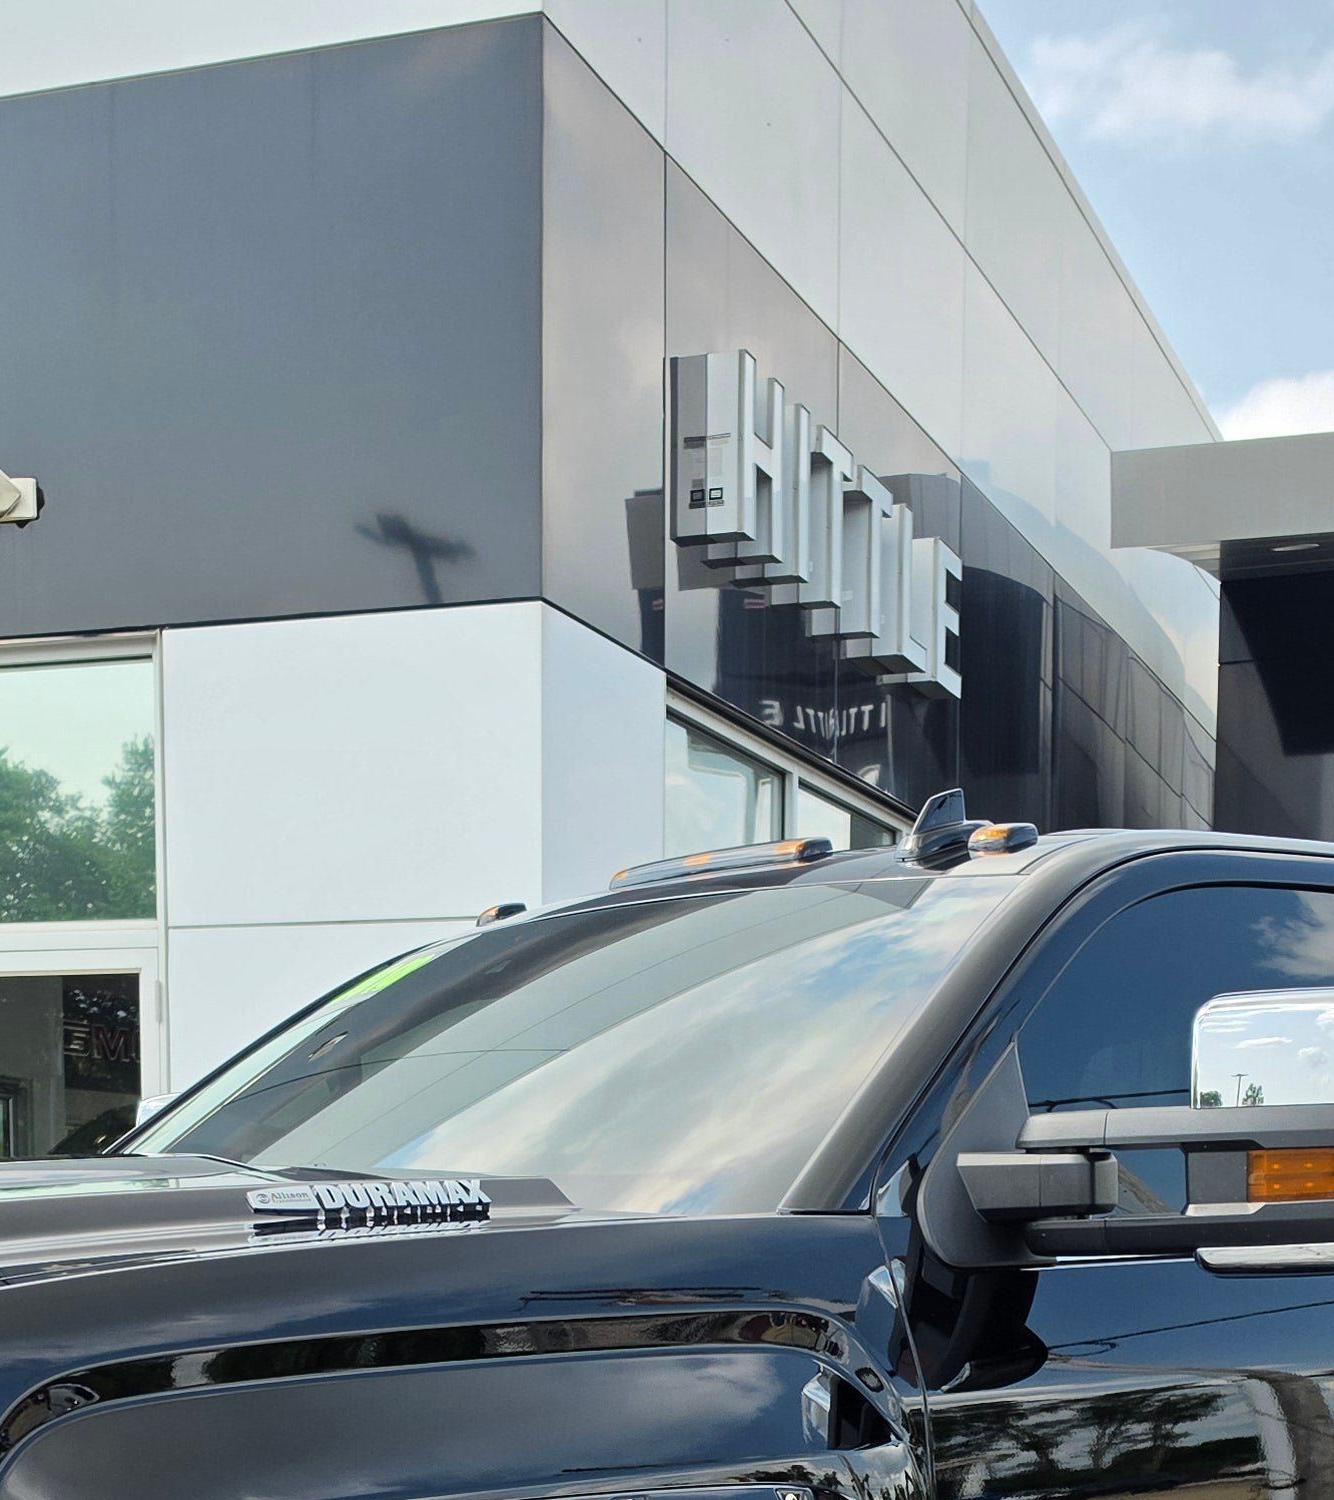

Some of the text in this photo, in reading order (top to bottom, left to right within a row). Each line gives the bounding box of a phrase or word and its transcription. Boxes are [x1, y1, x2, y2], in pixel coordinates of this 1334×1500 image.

[63, 1020, 140, 1062] GM
[271, 1179, 492, 1210] Allison DURAMAX
